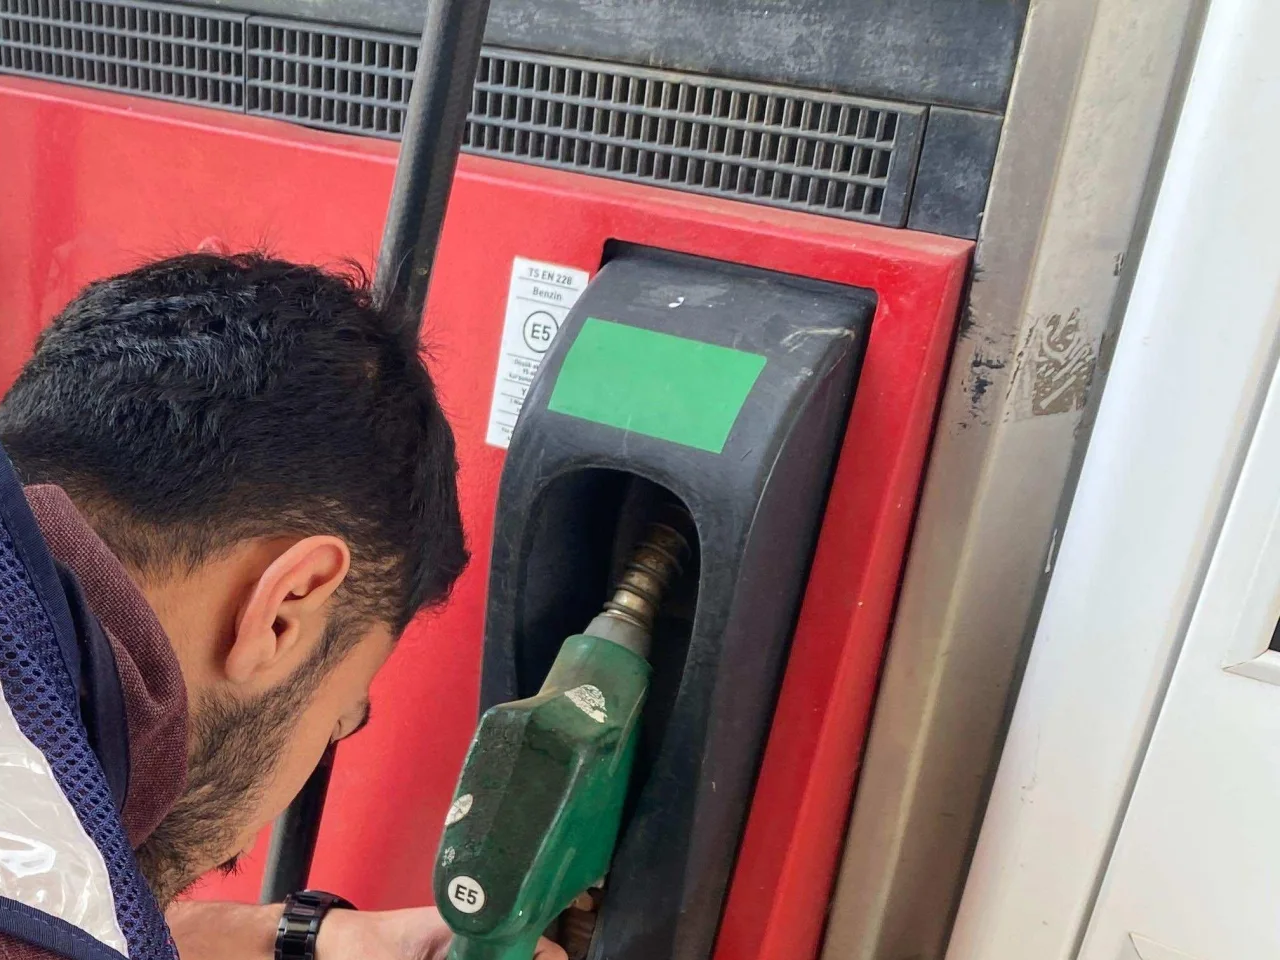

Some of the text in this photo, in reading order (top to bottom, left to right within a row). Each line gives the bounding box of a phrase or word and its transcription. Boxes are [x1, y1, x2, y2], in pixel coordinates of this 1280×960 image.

[528, 267, 573, 286] TS EN 228
[532, 286, 563, 301] Benzin
[531, 323, 551, 342] E5
[455, 884, 478, 905] E5
